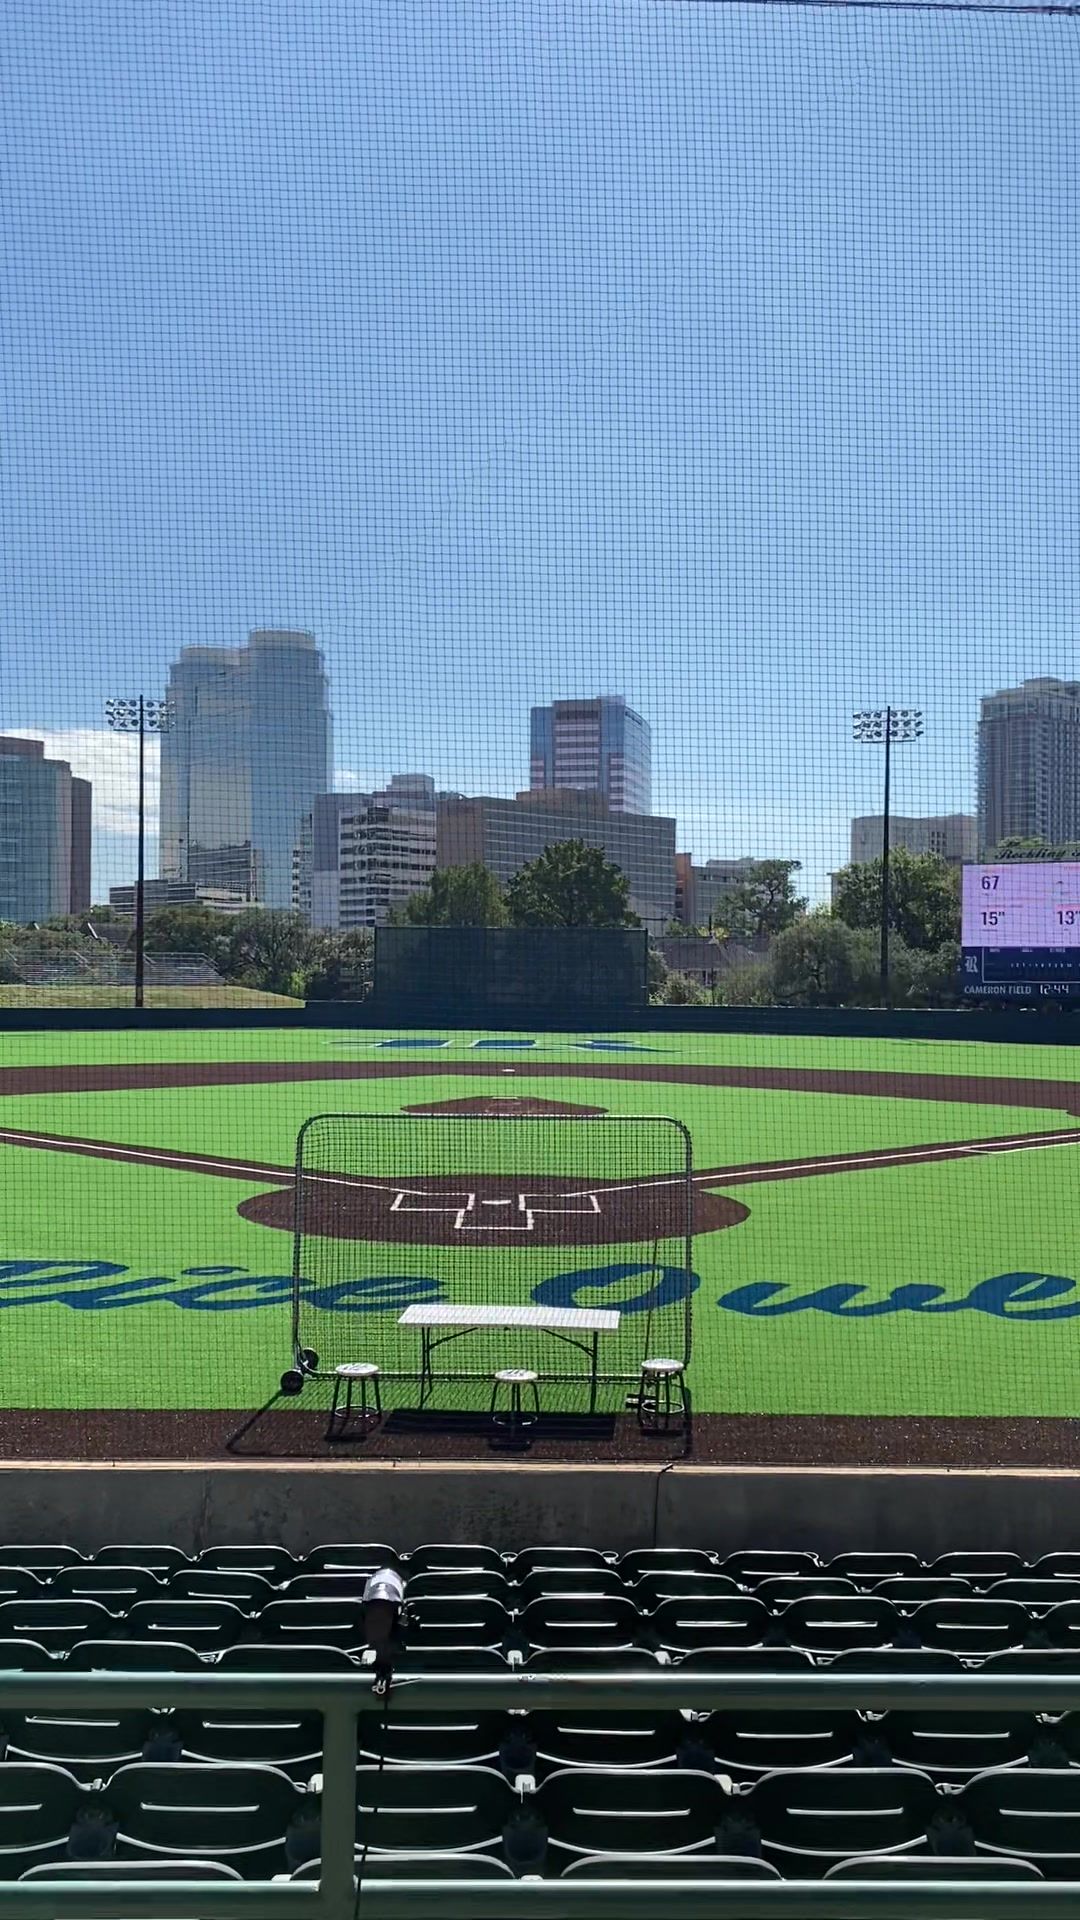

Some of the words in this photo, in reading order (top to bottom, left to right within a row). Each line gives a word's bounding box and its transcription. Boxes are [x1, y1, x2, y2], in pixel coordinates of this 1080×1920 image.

[981, 875, 1000, 890] 67
[964, 984, 1006, 994] CAMERON
[1008, 985, 1032, 994] FIELD
